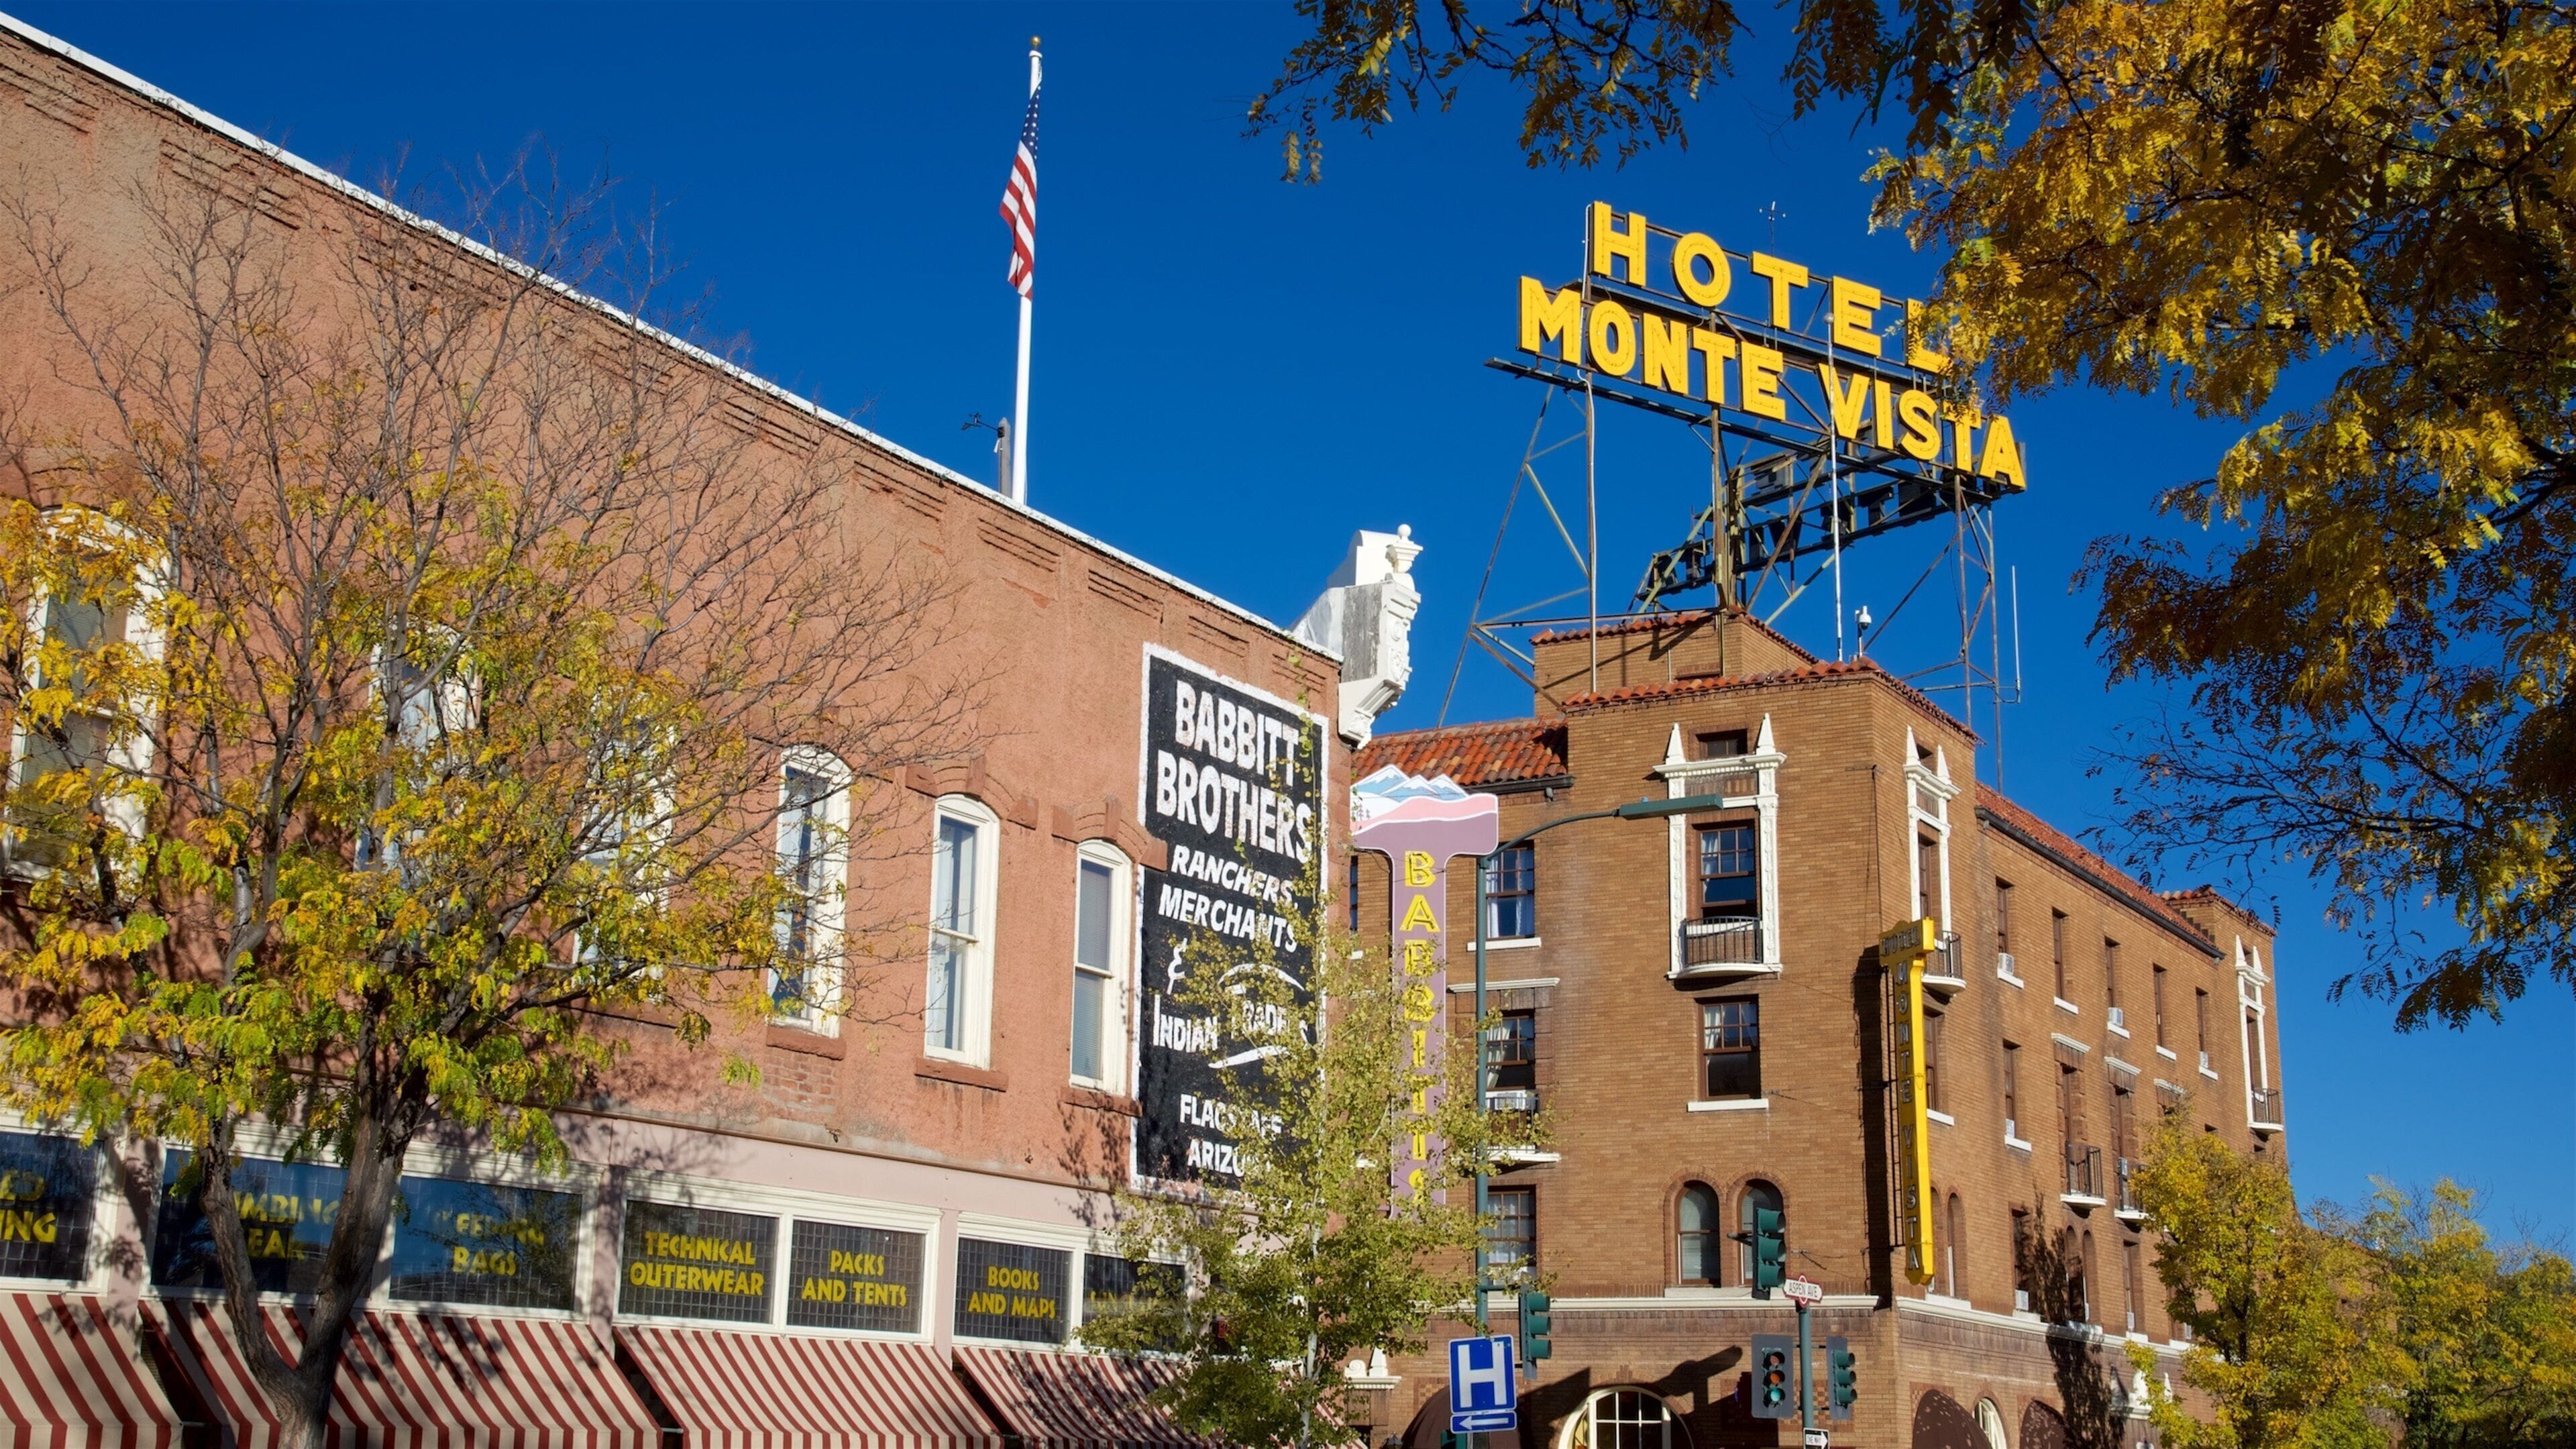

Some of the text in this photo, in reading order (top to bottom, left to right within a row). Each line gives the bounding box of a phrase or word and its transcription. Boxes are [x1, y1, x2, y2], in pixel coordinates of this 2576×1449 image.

[1590, 201, 1953, 376] HOTEL
[1519, 275, 2026, 488] MONTE VISTA
[1175, 679, 1299, 788] BABBITT
[1156, 749, 1313, 864] BROTHERS
[1158, 883, 1298, 953] MERCHANTS
[1879, 928, 1919, 957] HOTEL
[1152, 994, 1218, 1053] INDIAN
[1896, 961, 1920, 1271] MONTE VISTA
[452, 1245, 517, 1276] BAGS
[645, 1230, 756, 1265] TECHNICAL
[830, 1250, 885, 1276] PACKS
[629, 1261, 765, 1296] OUTERWEAR
[801, 1277, 907, 1307] AND TENTS
[987, 1266, 1039, 1291] BOOKS
[968, 1291, 1055, 1320] AND MAPS
[1457, 1340, 1507, 1408] H
